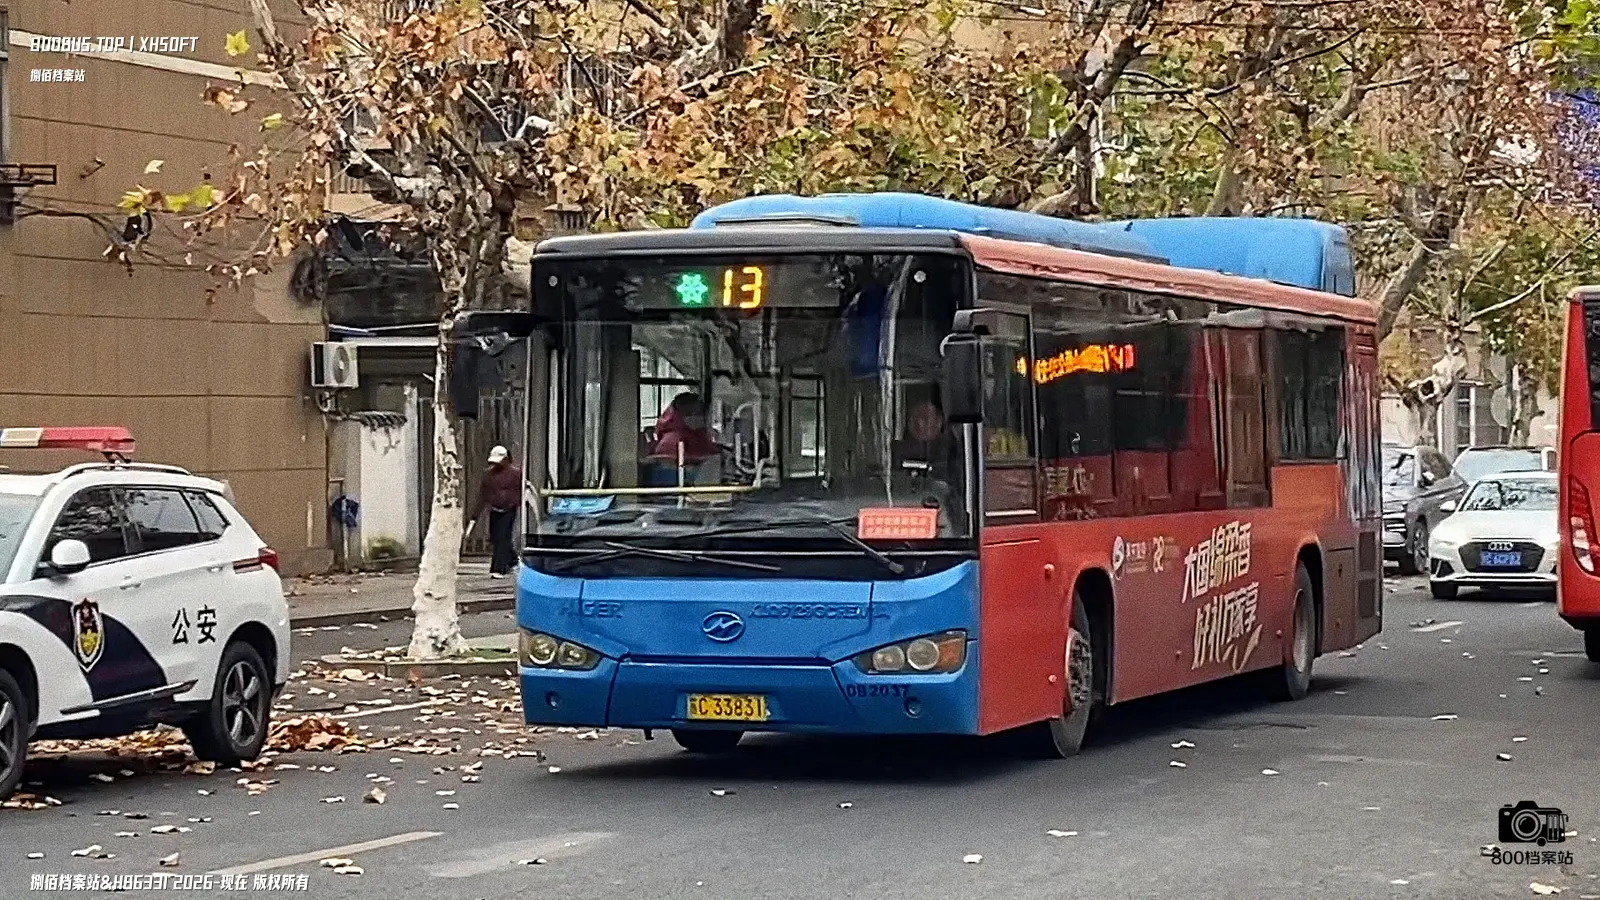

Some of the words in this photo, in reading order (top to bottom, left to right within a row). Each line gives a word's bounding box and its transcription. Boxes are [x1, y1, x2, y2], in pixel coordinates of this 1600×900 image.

[722, 265, 764, 309] 13
[171, 603, 218, 645] 公安
[560, 601, 623, 618] GER
